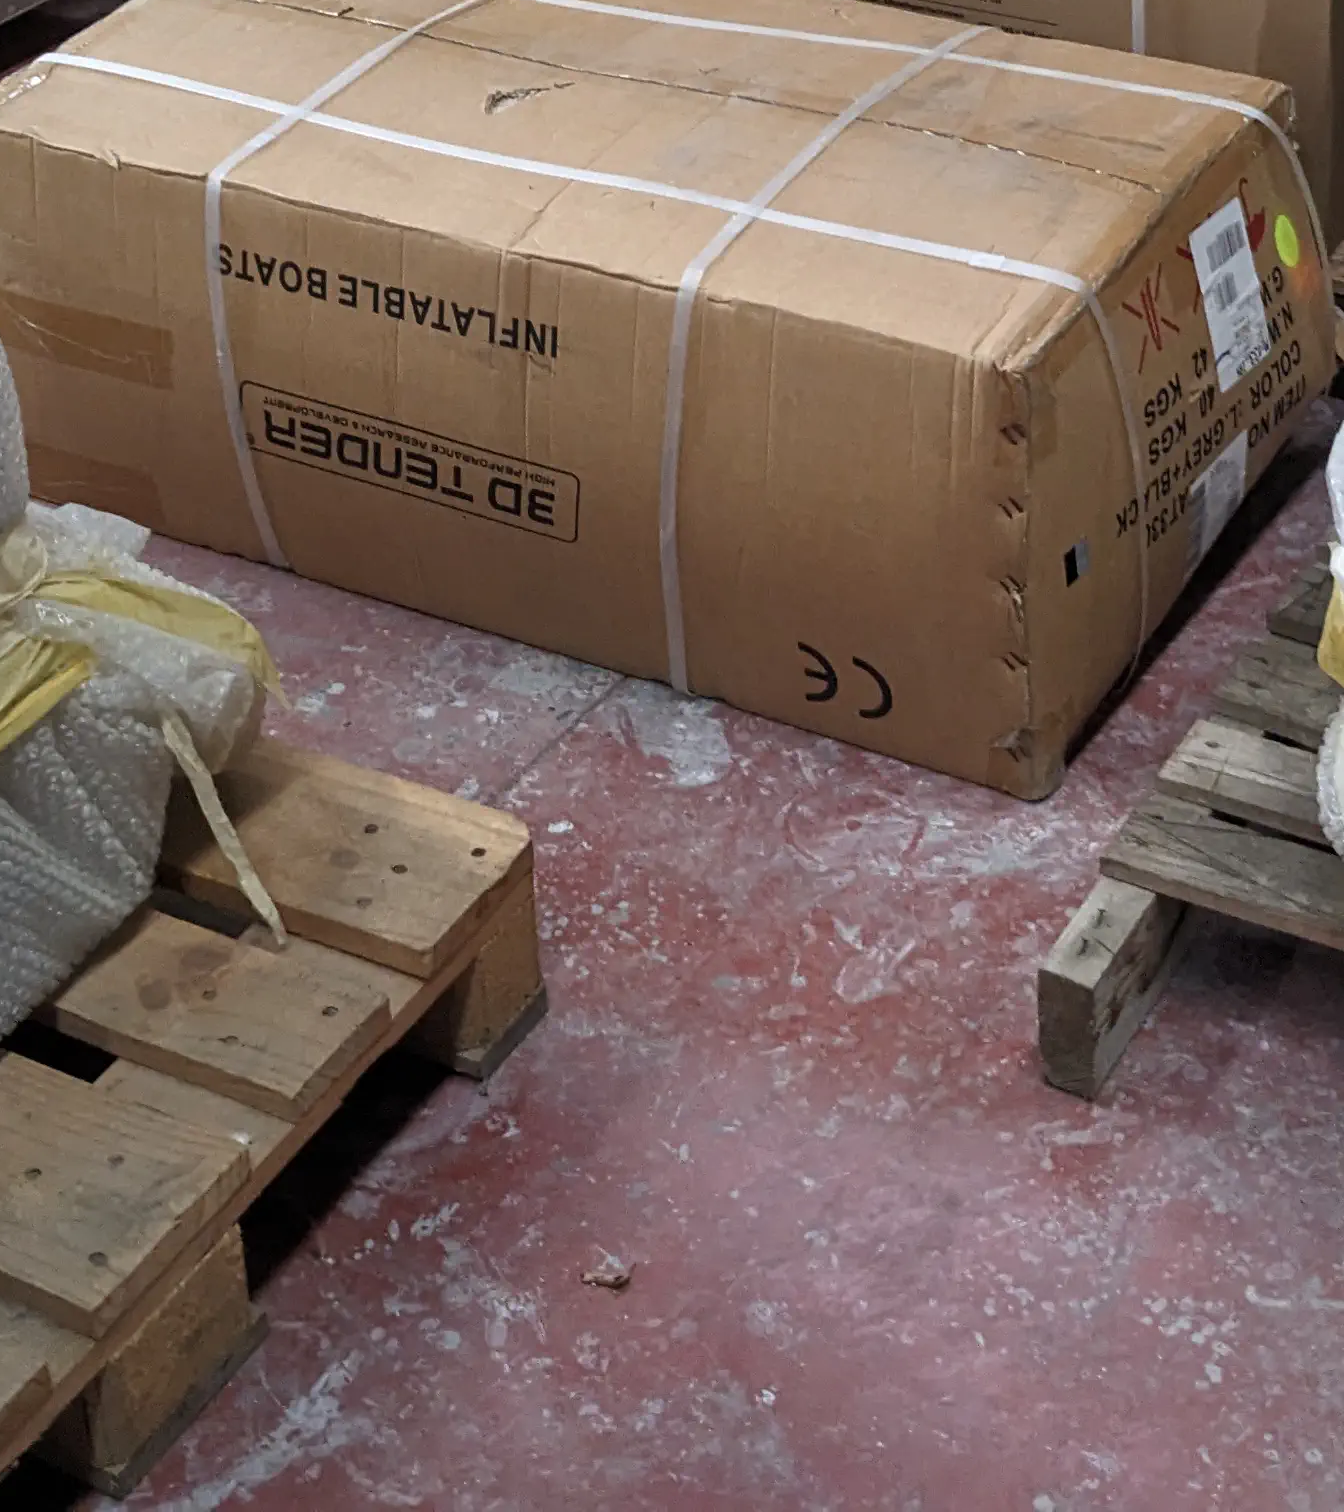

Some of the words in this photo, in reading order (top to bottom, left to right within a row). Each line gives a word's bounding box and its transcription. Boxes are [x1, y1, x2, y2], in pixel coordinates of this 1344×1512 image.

[218, 243, 328, 301] BOATS
[338, 273, 559, 358] INFLATABLE
[1143, 372, 1183, 428] KGS
[1250, 339, 1302, 411] COLOR
[1271, 373, 1307, 428] ITEM
[264, 409, 475, 503] TENDER
[1148, 411, 1187, 466] KGS
[488, 476, 555, 526] 3D
[525, 472, 555, 488] HIGH
